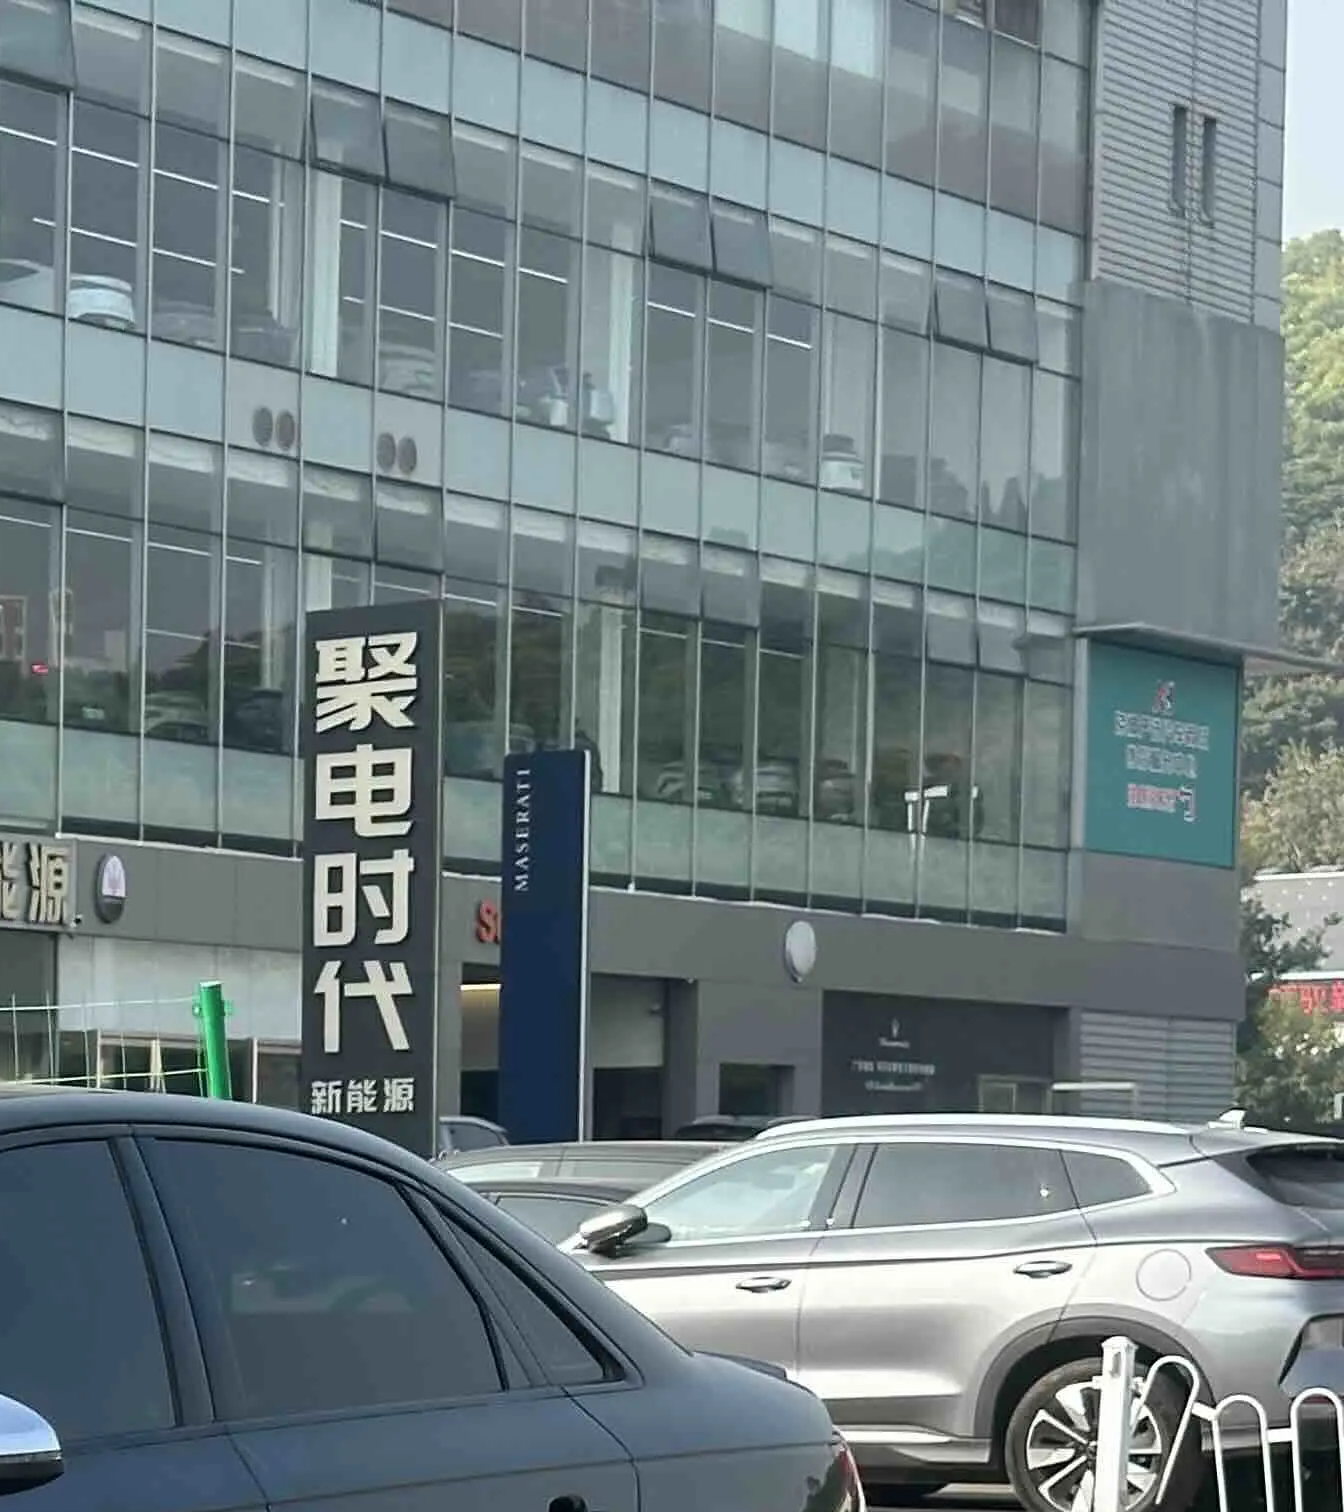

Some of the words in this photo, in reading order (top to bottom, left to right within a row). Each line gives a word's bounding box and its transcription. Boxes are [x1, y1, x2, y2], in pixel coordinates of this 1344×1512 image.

[313, 631, 418, 1053] 聚电时代
[513, 767, 533, 892] MASERATI
[310, 1077, 415, 1114] 新能源
